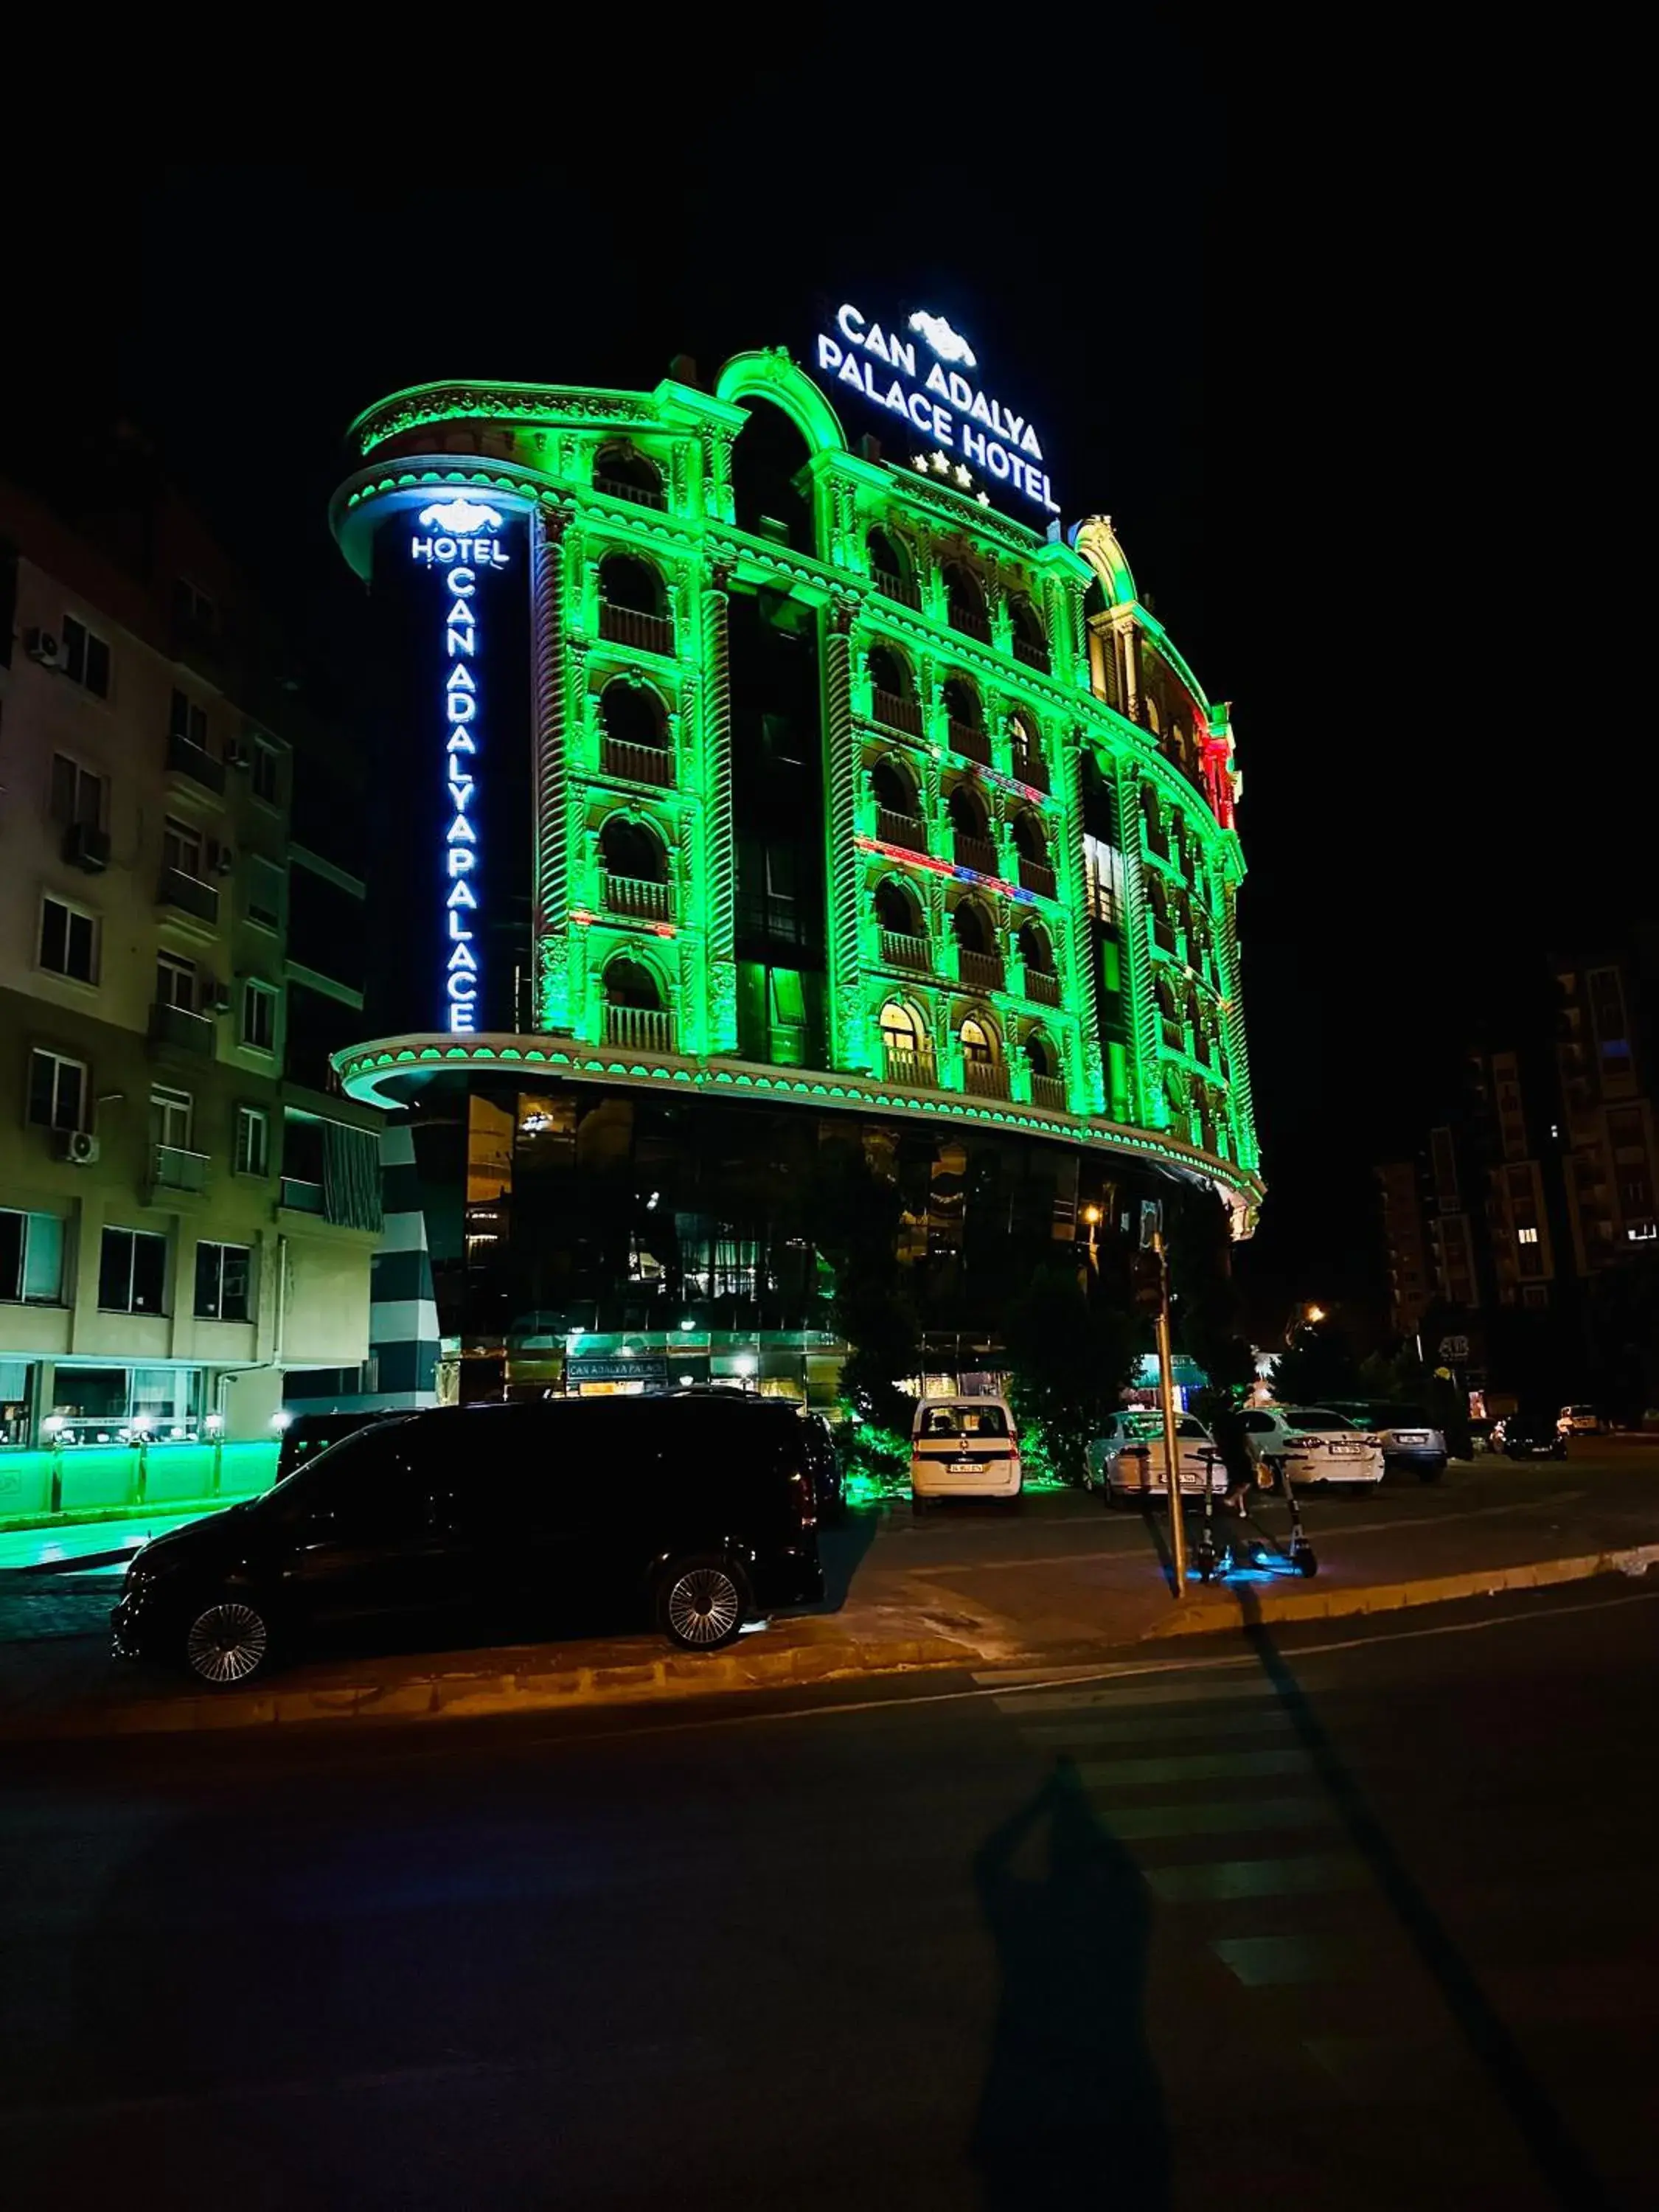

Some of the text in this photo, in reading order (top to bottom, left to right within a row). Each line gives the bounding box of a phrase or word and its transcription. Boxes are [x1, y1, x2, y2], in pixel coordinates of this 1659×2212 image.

[818, 333, 1061, 514] PALACE HOTEL
[838, 303, 1043, 461] CAN ADALYA
[411, 537, 510, 563] HOTEL
